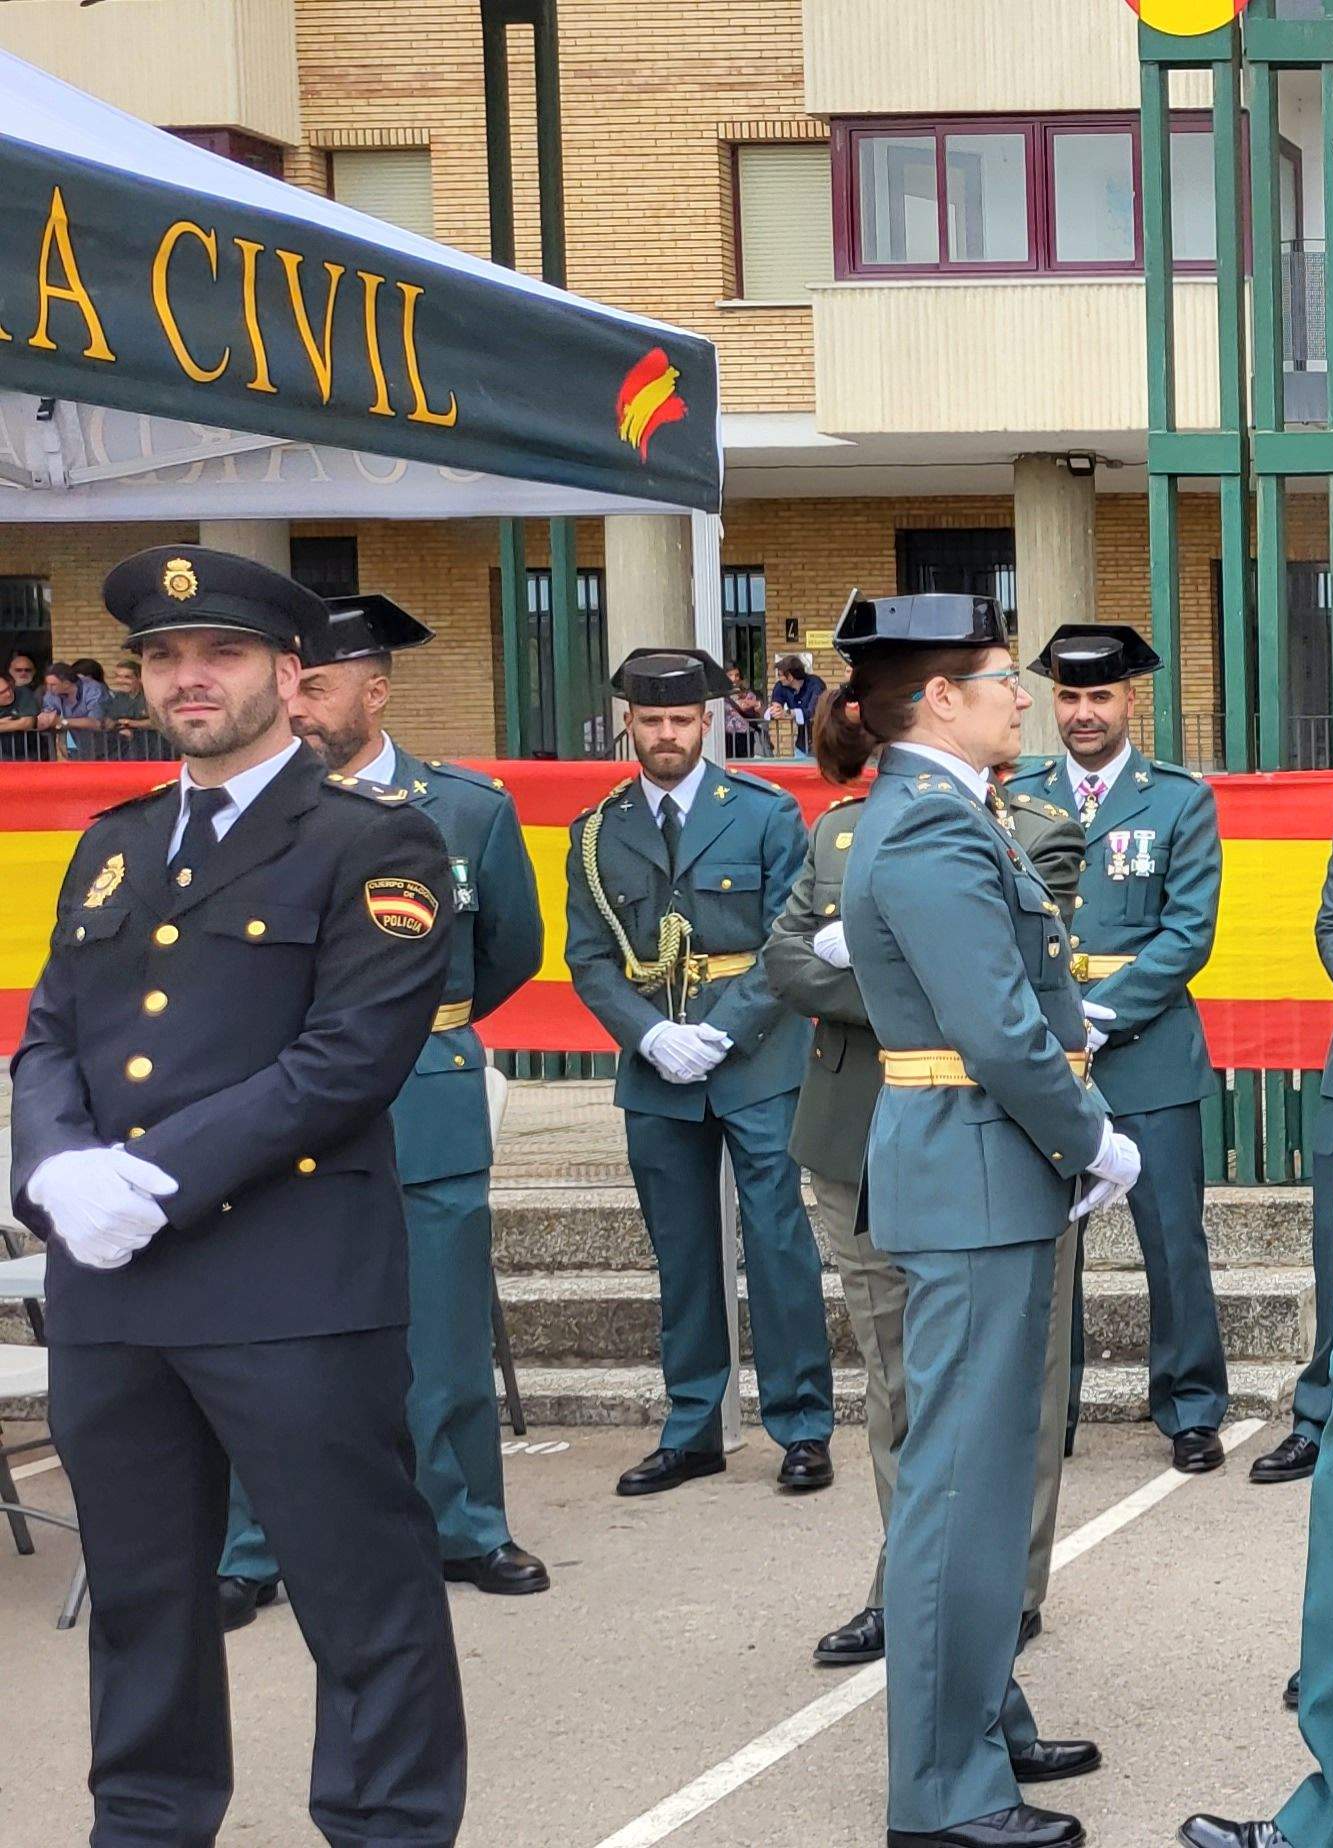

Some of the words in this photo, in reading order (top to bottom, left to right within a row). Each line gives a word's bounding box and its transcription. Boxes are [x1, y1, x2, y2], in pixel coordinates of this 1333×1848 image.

[0, 185, 117, 362] A
[151, 220, 458, 428] CIVIL
[369, 881, 404, 889] CUERPO
[403, 890, 415, 899] DE
[383, 915, 422, 933] POLICIA
